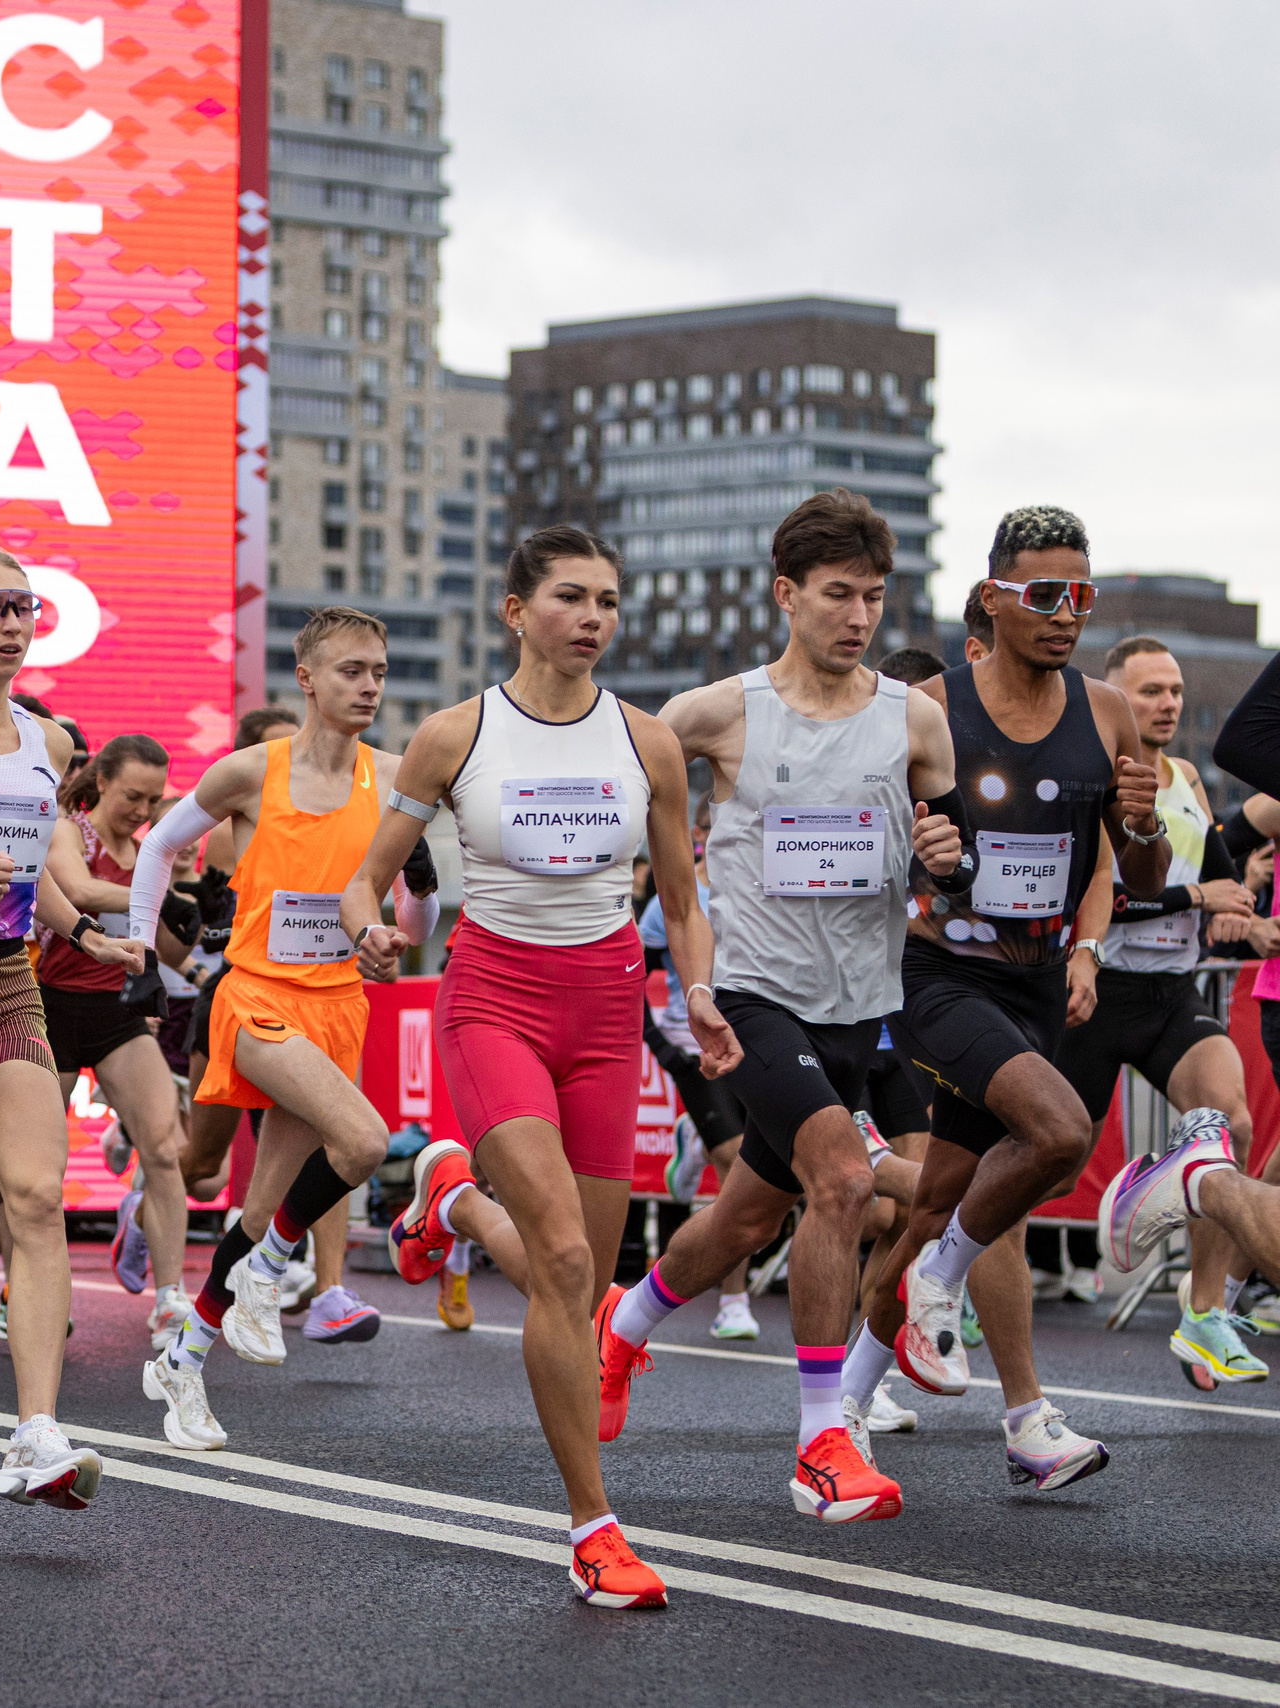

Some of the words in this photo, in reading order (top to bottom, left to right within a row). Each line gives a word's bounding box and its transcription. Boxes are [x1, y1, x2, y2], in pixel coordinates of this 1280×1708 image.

[512, 813, 621, 826] АПЛАЧКИНА
[562, 834, 576, 844] 17
[6, 845, 11, 854] 1
[776, 841, 874, 853] ДОМОРНИКОВ
[819, 859, 835, 869] 24
[1002, 864, 1056, 879] БУРЦЕВ
[1025, 883, 1037, 893] 18
[1127, 901, 1163, 910] COROS
[314, 935, 325, 943] 16
